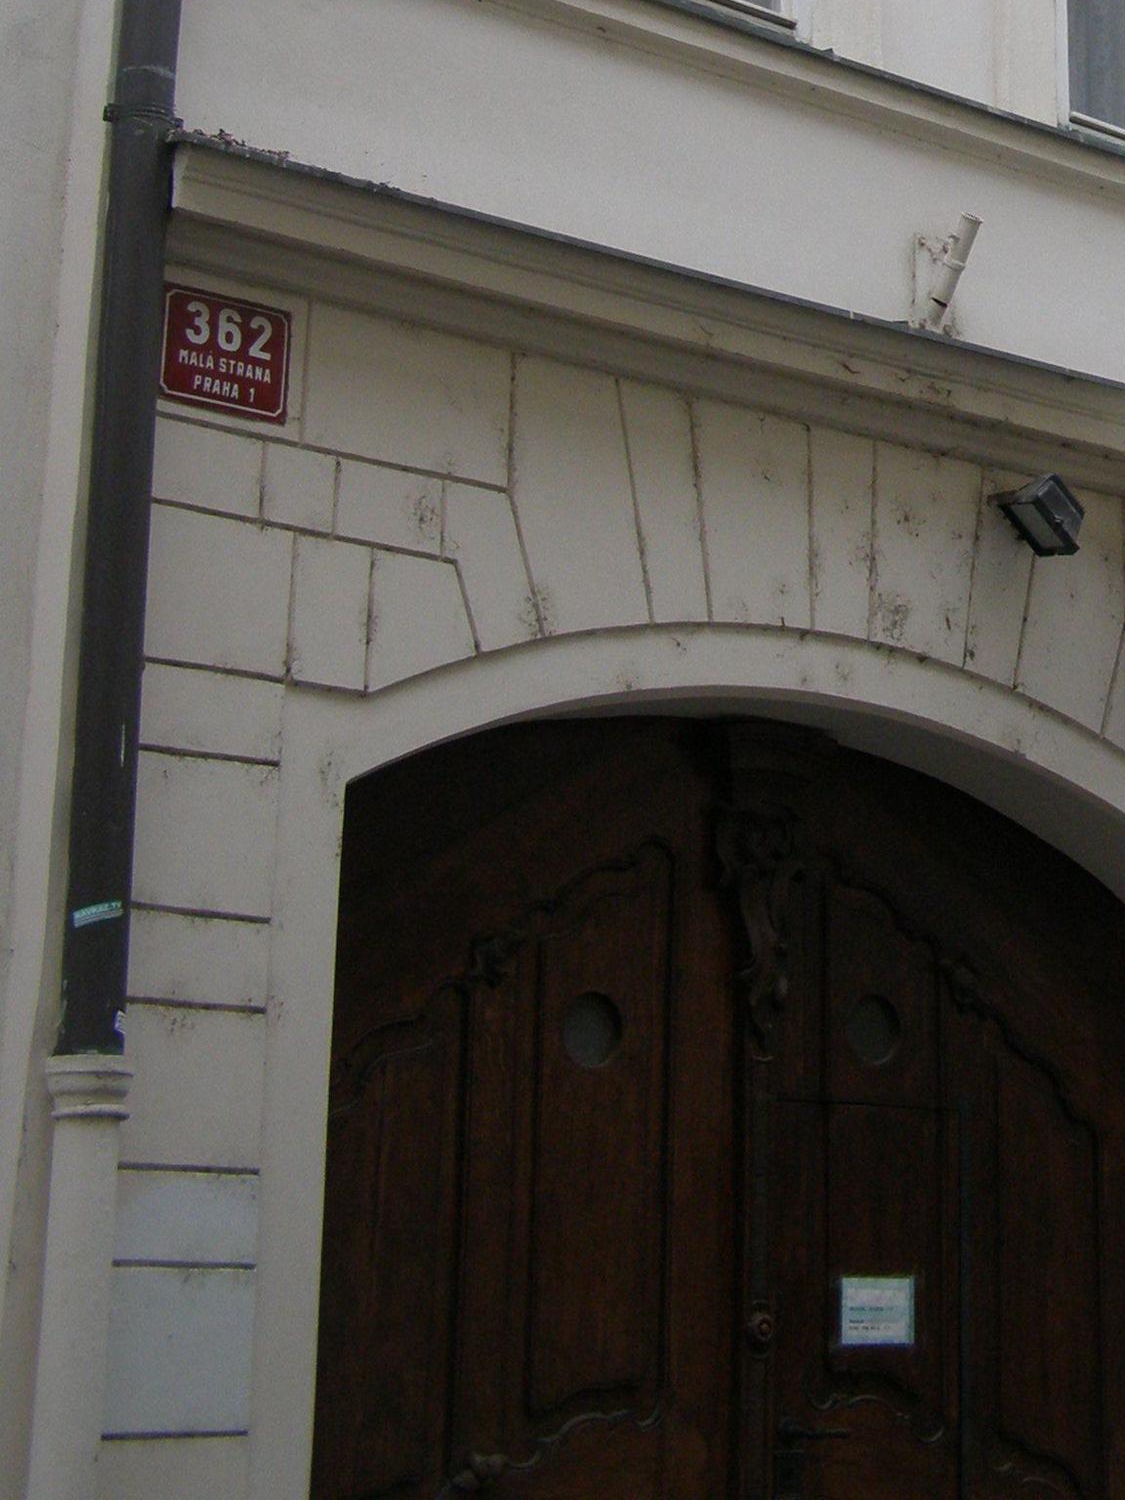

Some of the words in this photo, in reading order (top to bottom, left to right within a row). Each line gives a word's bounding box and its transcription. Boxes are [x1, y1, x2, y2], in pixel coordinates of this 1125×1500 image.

[185, 301, 273, 361] 362
[179, 349, 215, 370] MALÁ
[219, 358, 272, 384] STRANA
[193, 375, 239, 400] PRAHA
[248, 387, 256, 403] 1
